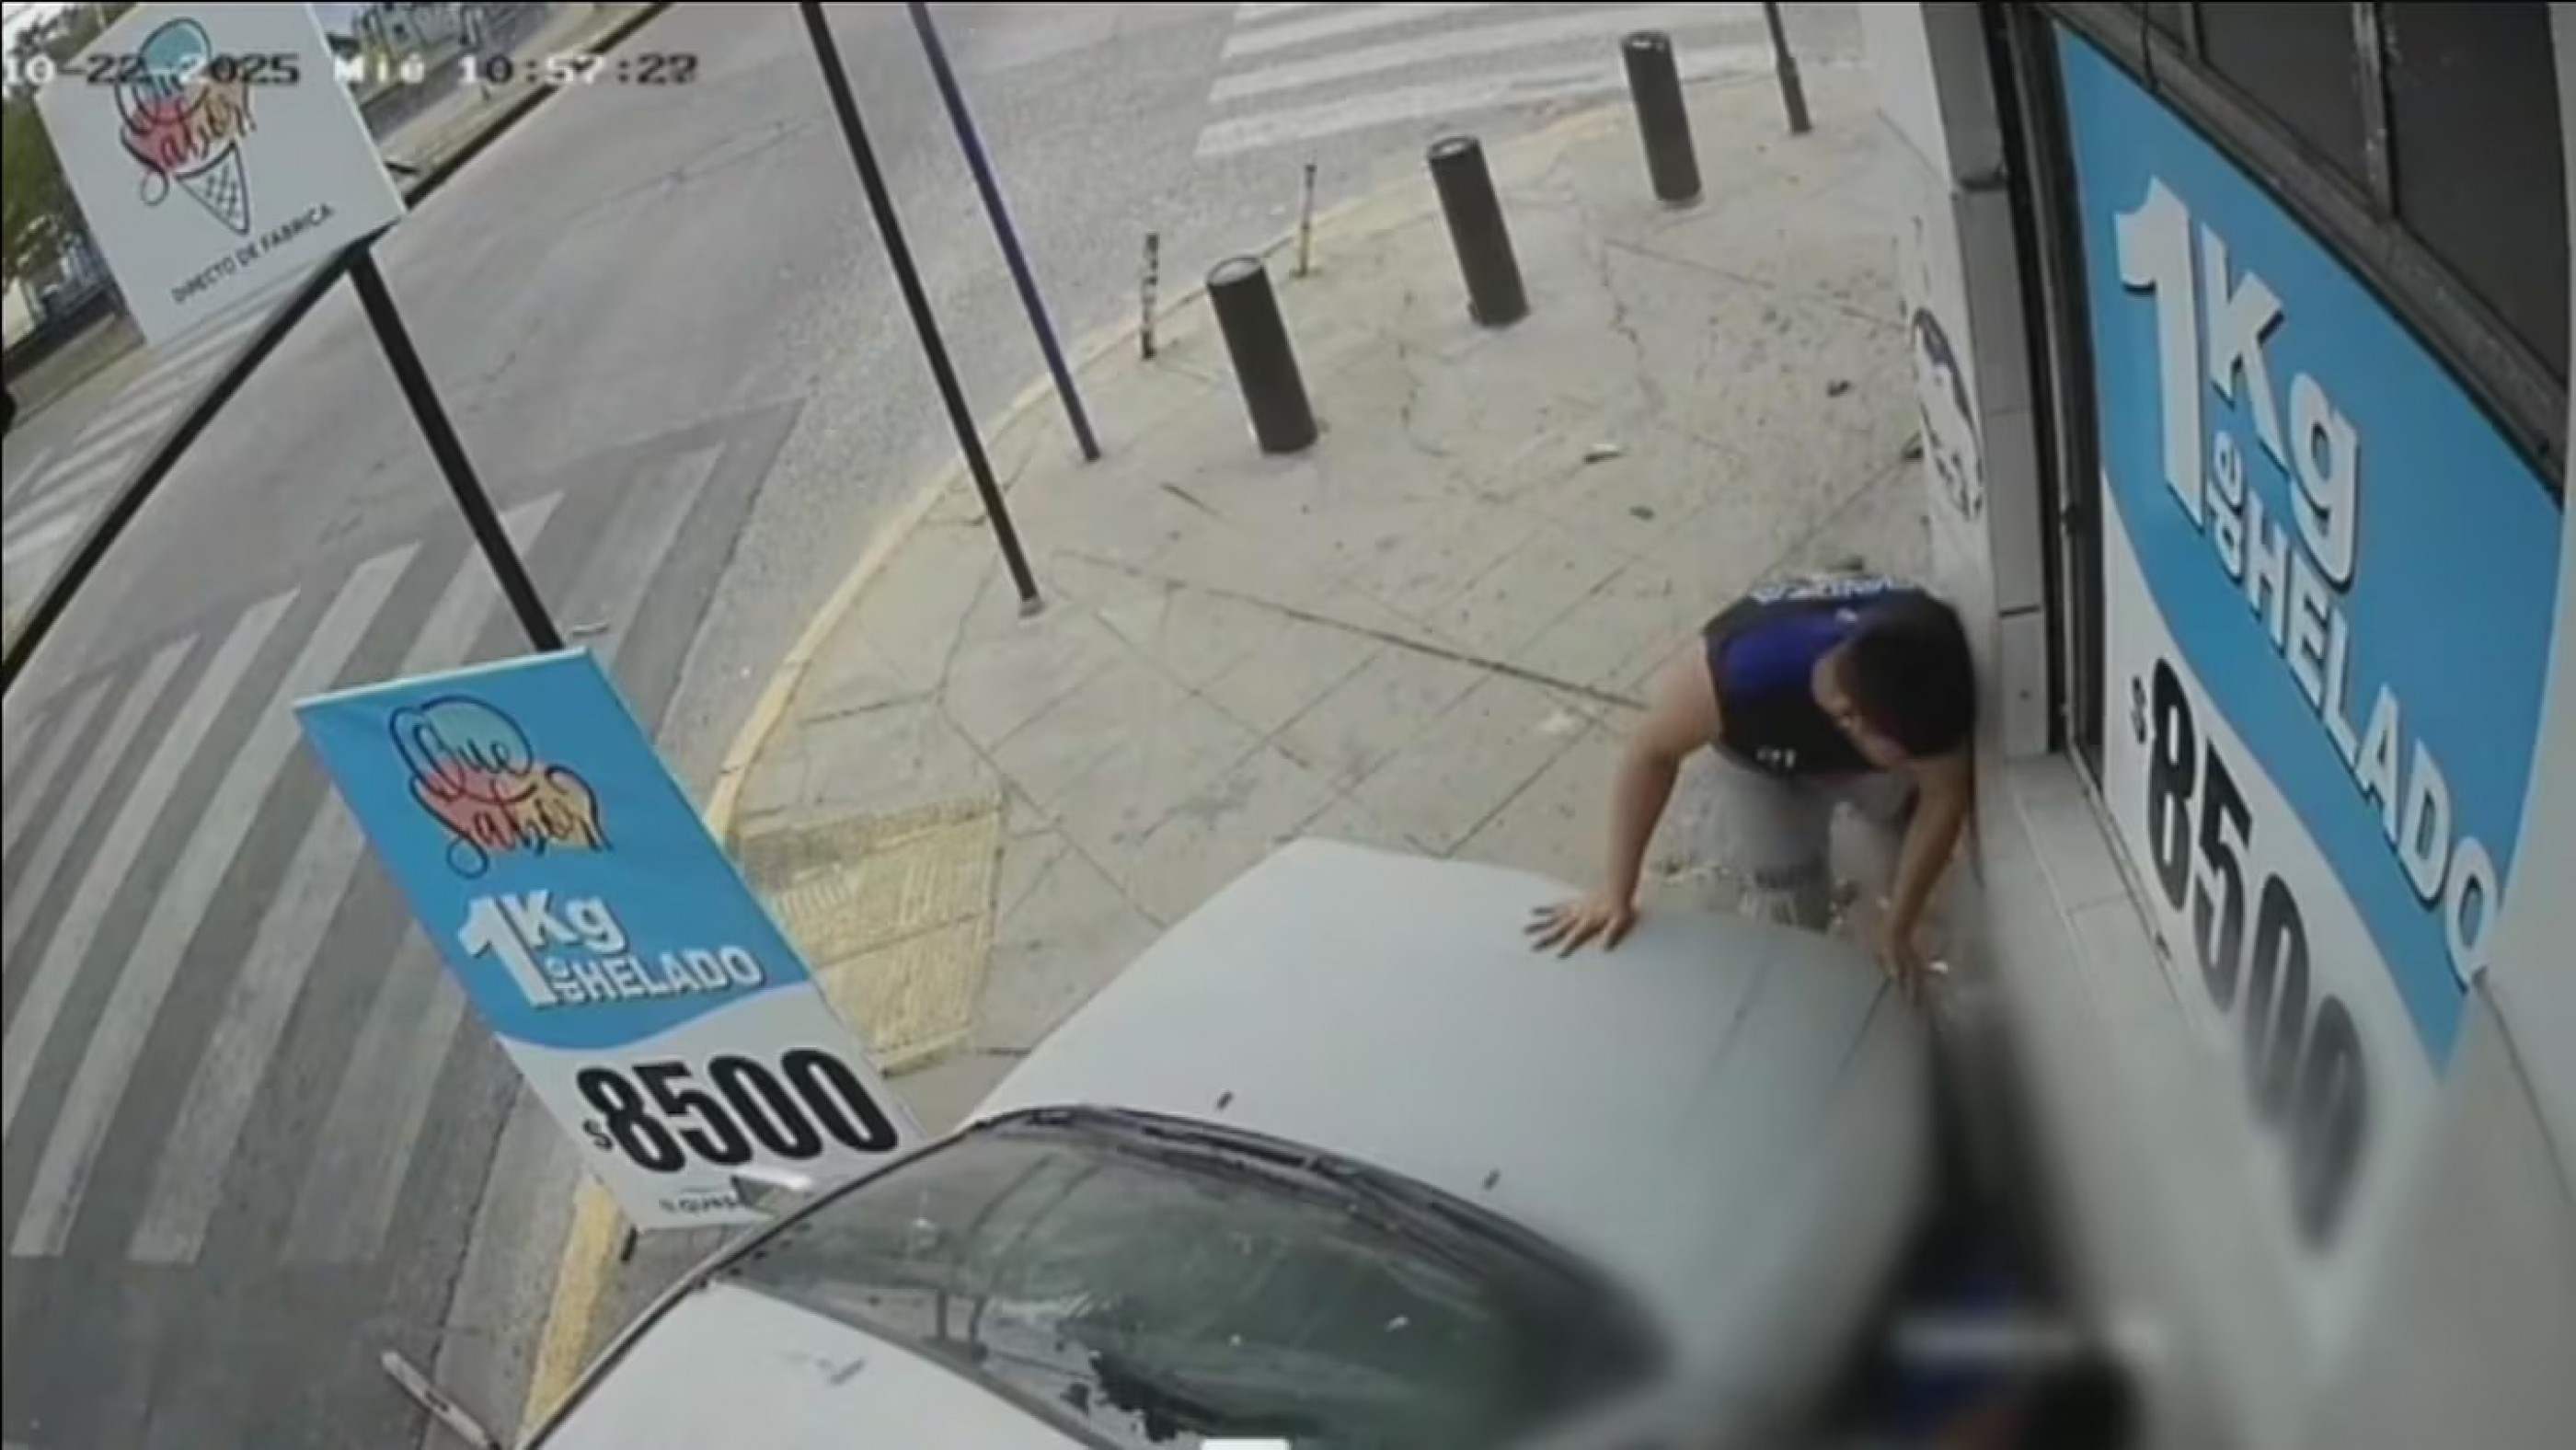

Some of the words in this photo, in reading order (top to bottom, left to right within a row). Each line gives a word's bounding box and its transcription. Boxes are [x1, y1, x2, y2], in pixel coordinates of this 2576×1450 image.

[171, 256, 237, 304] DIRECTO
[236, 242, 259, 267] DE
[259, 202, 335, 254] FABRICA
[2248, 489, 2502, 994] HELADO
[566, 945, 766, 1003] HELADO
